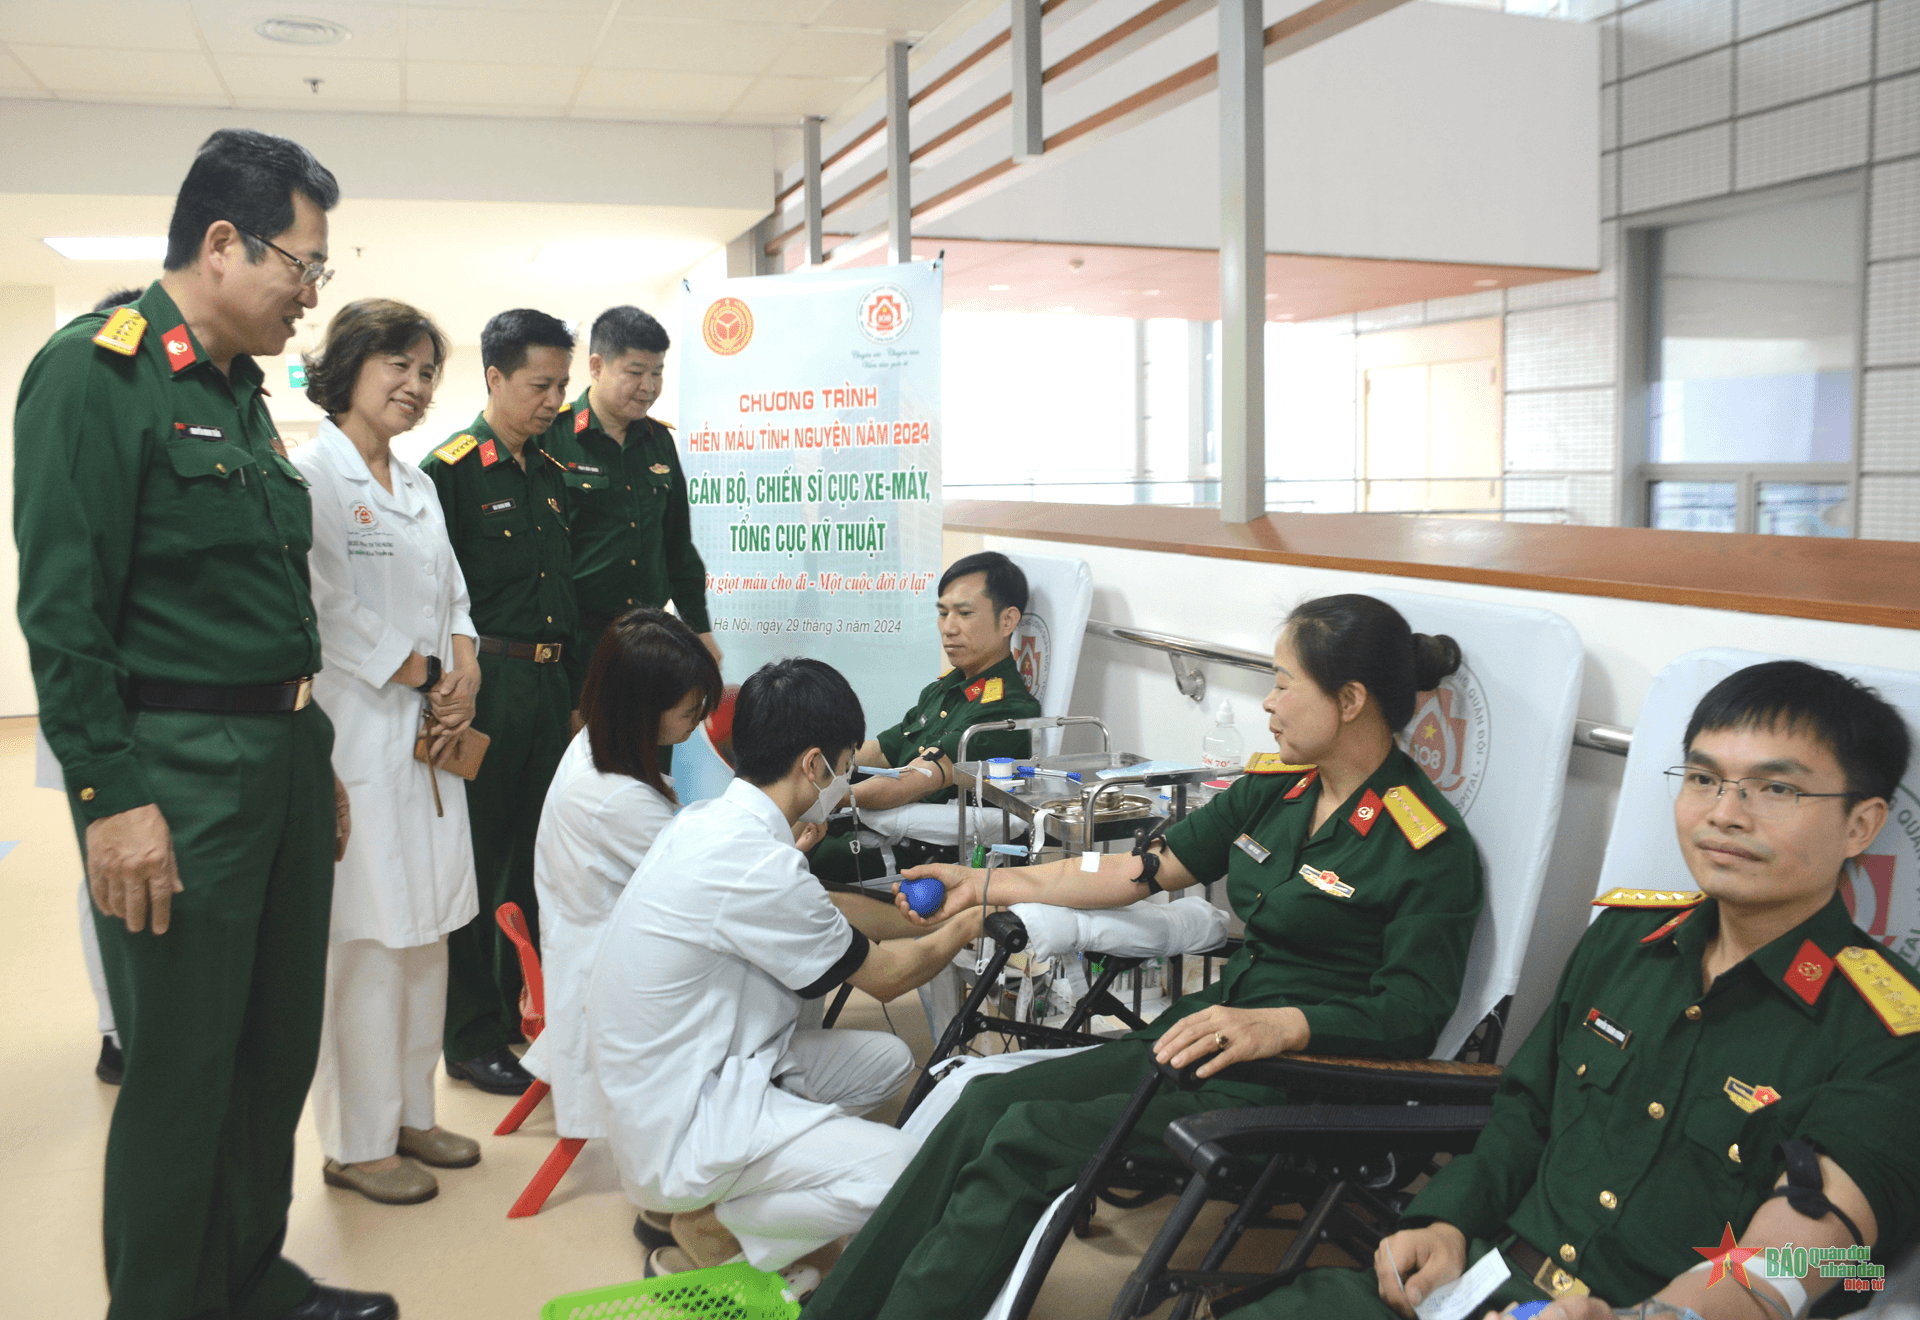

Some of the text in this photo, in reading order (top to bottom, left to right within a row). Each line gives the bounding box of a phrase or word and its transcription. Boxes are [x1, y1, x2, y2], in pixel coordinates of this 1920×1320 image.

[739, 380, 877, 413] CHƯƠNG TRÌNH
[690, 419, 930, 452] HIẾN MÁU TÌNH NGUYỆN NĂM 2024
[689, 464, 930, 510] CÁN BỘ, CHIẾN SĨ CỤC XE-MÁY,
[730, 513, 886, 559] TỔNG CỤC KỸ THUẬT
[716, 572, 741, 595] giọt
[742, 572, 768, 590] máu
[771, 572, 793, 590] cho
[795, 572, 808, 590] đi
[817, 572, 843, 595] Một
[845, 572, 874, 595] cuộc
[876, 572, 897, 590] đời
[899, 572, 908, 591] ở
[713, 618, 902, 636] Hà Nội, ngày 29 tháng 3 năm 2024
[1413, 743, 1442, 770] 108
